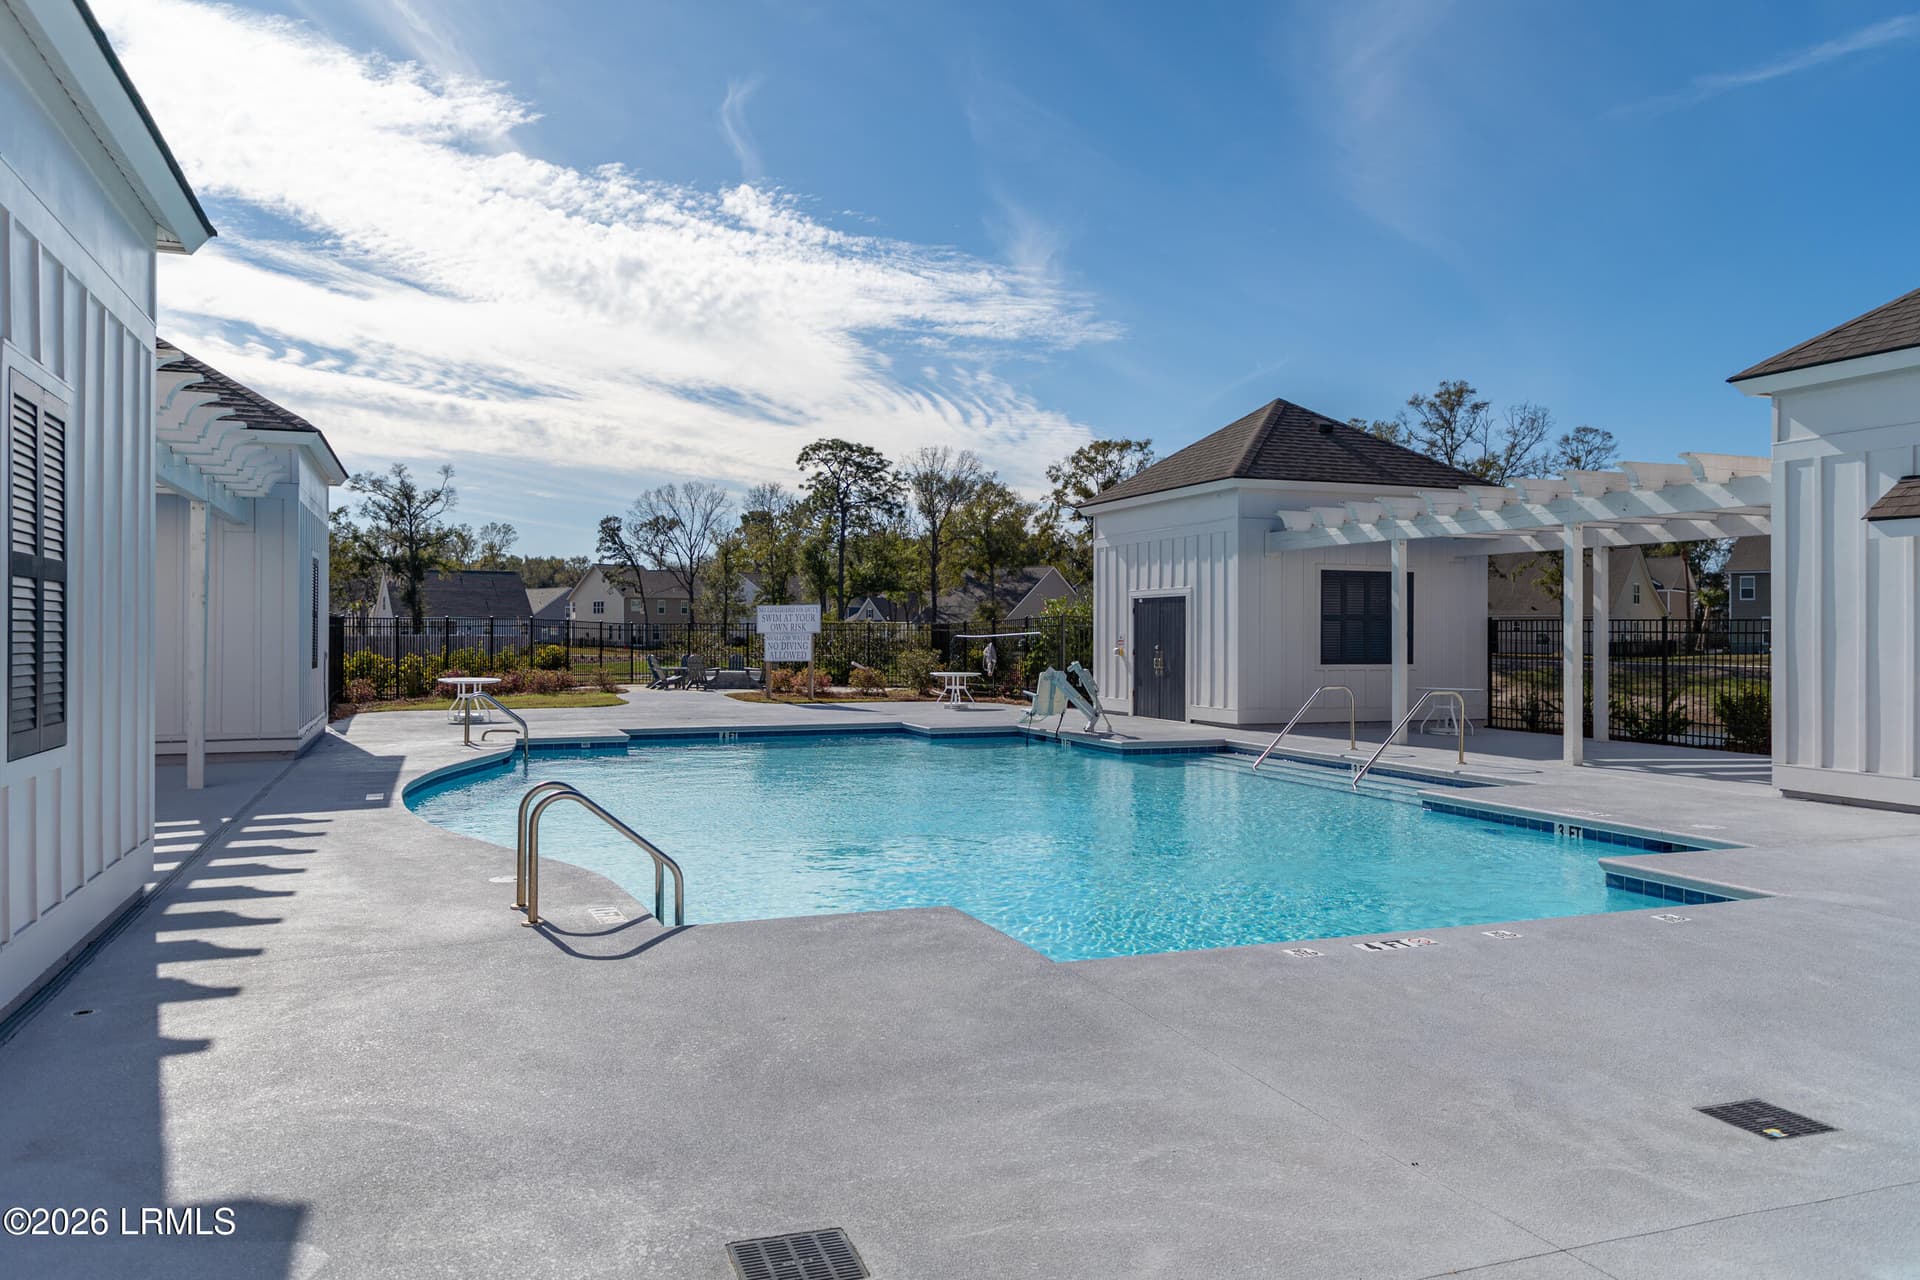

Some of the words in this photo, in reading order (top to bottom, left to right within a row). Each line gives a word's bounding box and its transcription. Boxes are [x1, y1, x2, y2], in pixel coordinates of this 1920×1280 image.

[761, 613, 782, 623] SWIM
[783, 613, 793, 622] AT
[795, 613, 816, 622] YOUR
[770, 622, 788, 632] OWN
[790, 622, 807, 632] RISK
[768, 641, 779, 650] NO
[781, 641, 809, 650] DIVING
[769, 651, 807, 660] ALLOWED
[1558, 824, 1565, 836] 3
[1568, 826, 1582, 838] FT
[1380, 939, 1410, 949] FT
